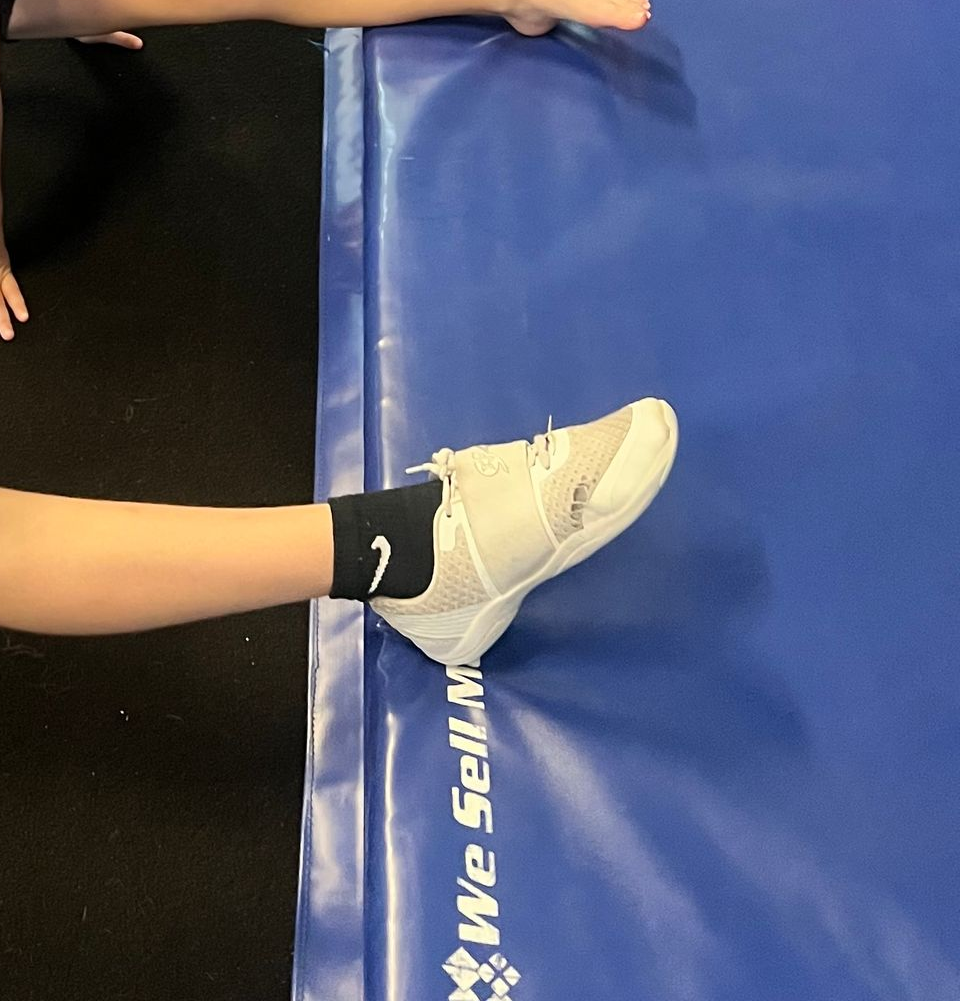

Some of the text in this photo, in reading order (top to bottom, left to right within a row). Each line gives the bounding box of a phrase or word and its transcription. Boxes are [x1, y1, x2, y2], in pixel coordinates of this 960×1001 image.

[446, 657, 500, 946] We Sell M
